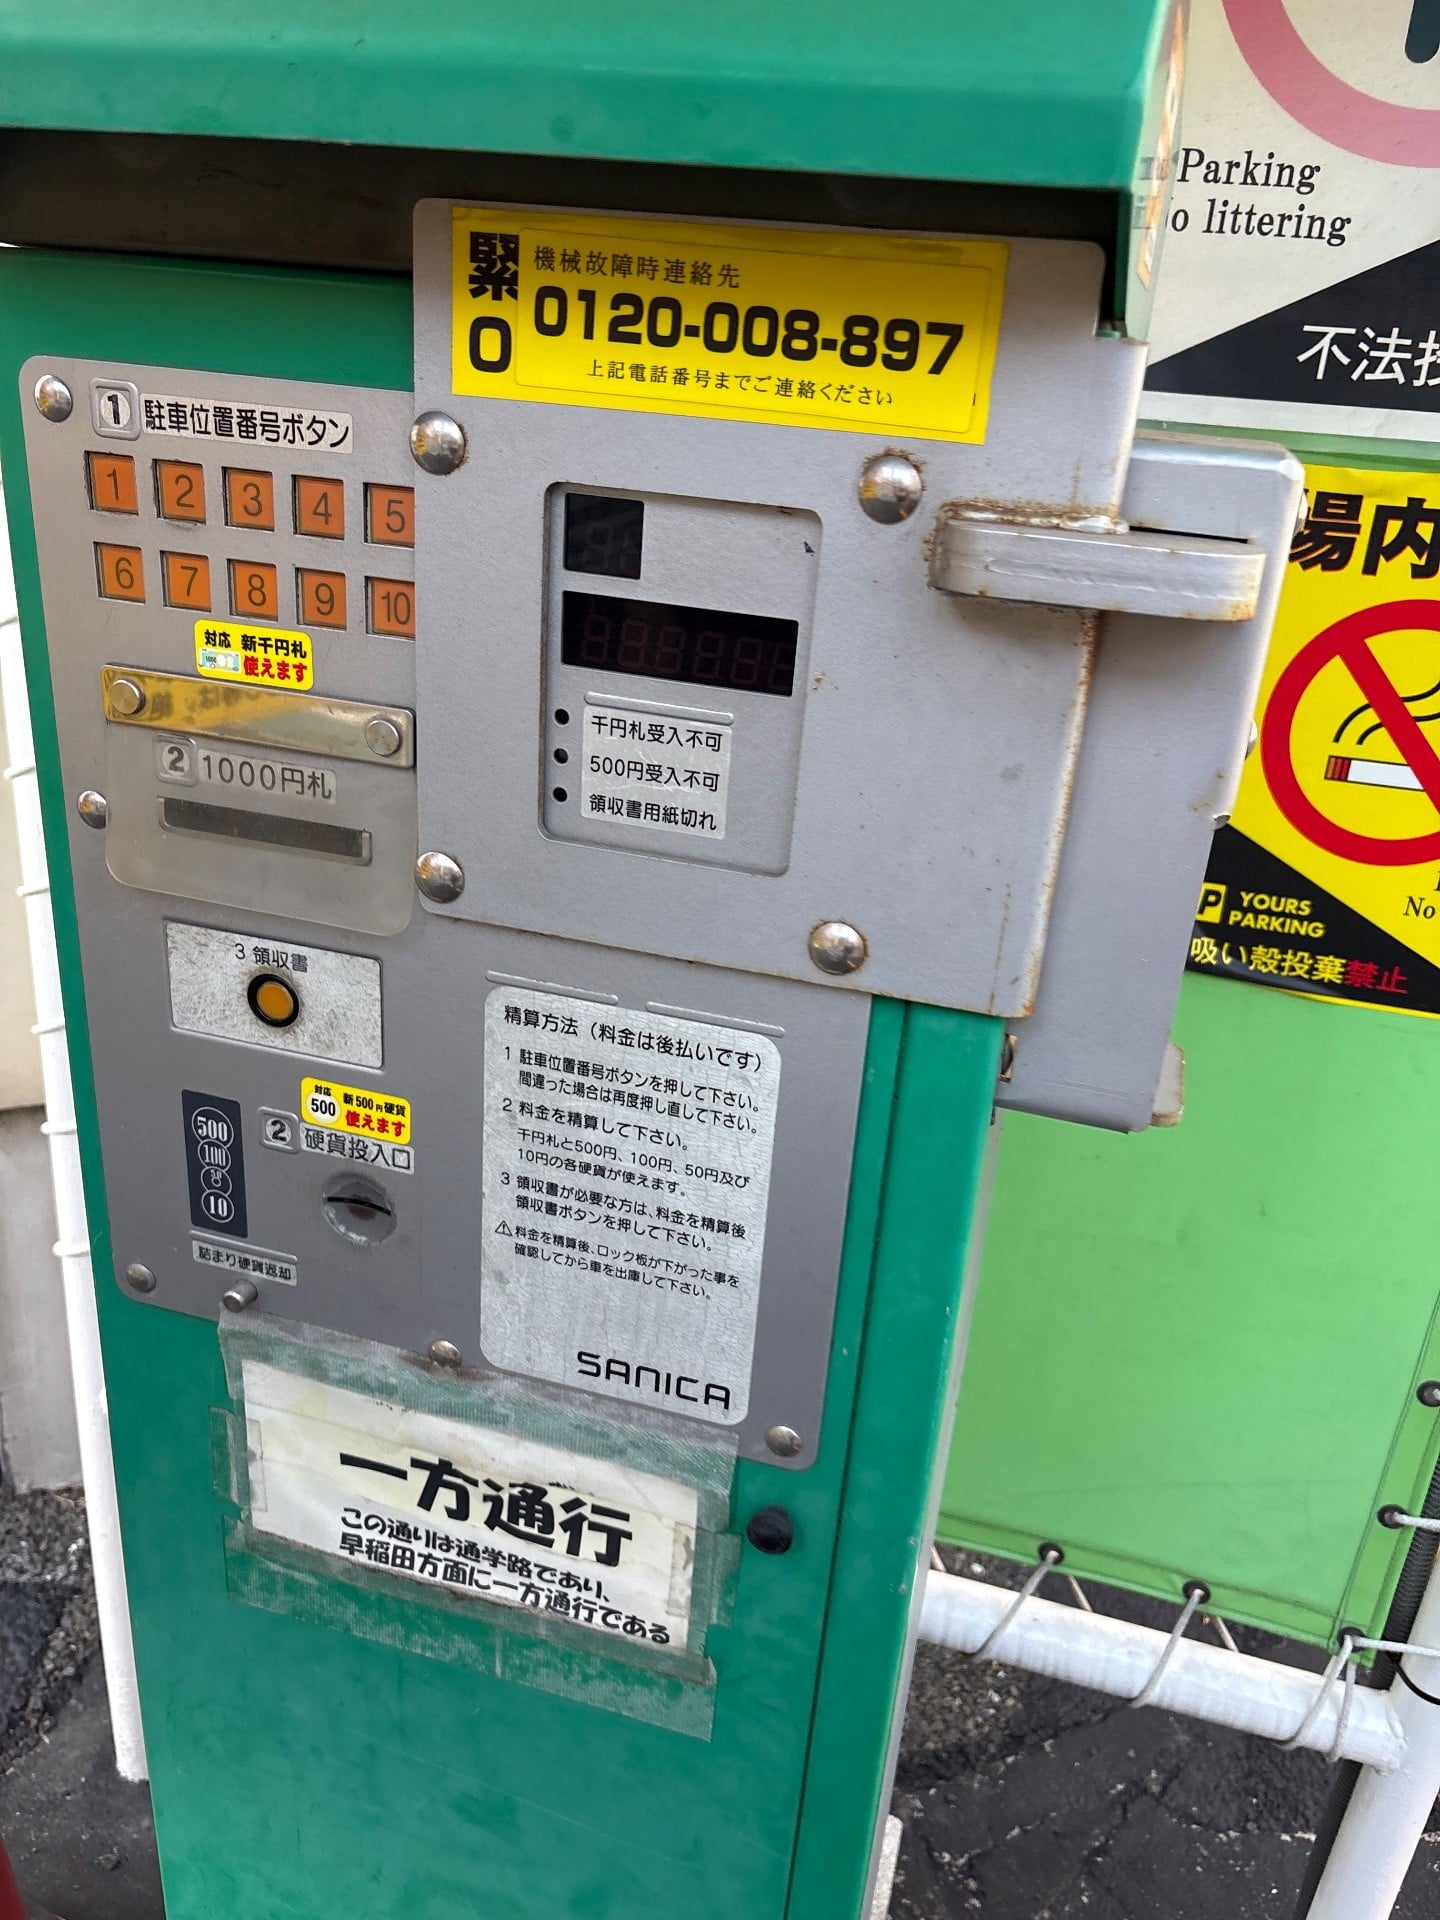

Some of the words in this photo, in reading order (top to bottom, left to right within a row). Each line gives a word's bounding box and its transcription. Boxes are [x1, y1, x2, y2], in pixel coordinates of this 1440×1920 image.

[1177, 147, 1321, 195] Parking
[1202, 198, 1352, 247] littering
[532, 245, 741, 289] 機械故障時連絡先
[533, 284, 965, 375] 0120-008-897
[586, 358, 894, 407] 上記電話番号までご連絡ください
[106, 393, 120, 426] 1
[144, 398, 350, 447] 駐車位置番号ボタン
[106, 469, 120, 501] 1
[175, 474, 195, 509] 2
[242, 483, 263, 517] 3
[312, 492, 333, 525] 4
[385, 500, 406, 533] 5
[115, 557, 135, 590] 6
[180, 566, 199, 596] 7
[247, 574, 267, 606] 8
[314, 583, 335, 616] 9
[381, 592, 411, 625] 10
[204, 629, 231, 648] 対応
[241, 634, 307, 658] 新千円札
[243, 655, 308, 682] 使えます
[590, 715, 723, 752] 千円札受入不可
[167, 746, 184, 772] 2
[202, 755, 332, 800] 1000円札
[589, 756, 720, 792] 500円受入不可
[589, 793, 717, 831] 領収書用紙切れ
[1228, 909, 1327, 939] PARKING
[1239, 890, 1313, 917] YOURS
[1403, 895, 1436, 920] No
[234, 942, 246, 960] 3
[253, 945, 309, 973] 領収書
[1190, 936, 1408, 995] 吸い殻投棄禁止
[504, 1046, 512, 1060] 1
[519, 1048, 760, 1113] 駐車位置番号ボタンを押して下さい。
[519, 1070, 757, 1135] 間違った場合は再度押し直して下さい。
[197, 1116, 228, 1142] 500
[311, 1097, 335, 1116] 500
[345, 1110, 406, 1137] 使えます
[502, 1099, 513, 1112] 2
[519, 1101, 690, 1151] 料金を精算して下さい。
[204, 1144, 226, 1166] 100
[270, 1119, 287, 1142] 2
[305, 1127, 411, 1170] 硬貨投入口
[517, 1147, 686, 1196] 10円の各硬貨が使えます。
[209, 1195, 228, 1217] 10
[500, 1173, 511, 1186] 3
[516, 1174, 747, 1240] 領収書が必要な方は、料金を精算後
[515, 1194, 713, 1252] 領収書ボタンを押して下さい。
[198, 1246, 291, 1280] 詰まり硬貨返却
[514, 1243, 712, 1300] 確認してから車を出庫して下さい。
[577, 1350, 732, 1411] SANICA
[339, 1452, 633, 1567] 一方通行
[340, 1507, 610, 1603] この通りは通学路であり、
[339, 1535, 670, 1646] 早稲田方面に一方通行である
